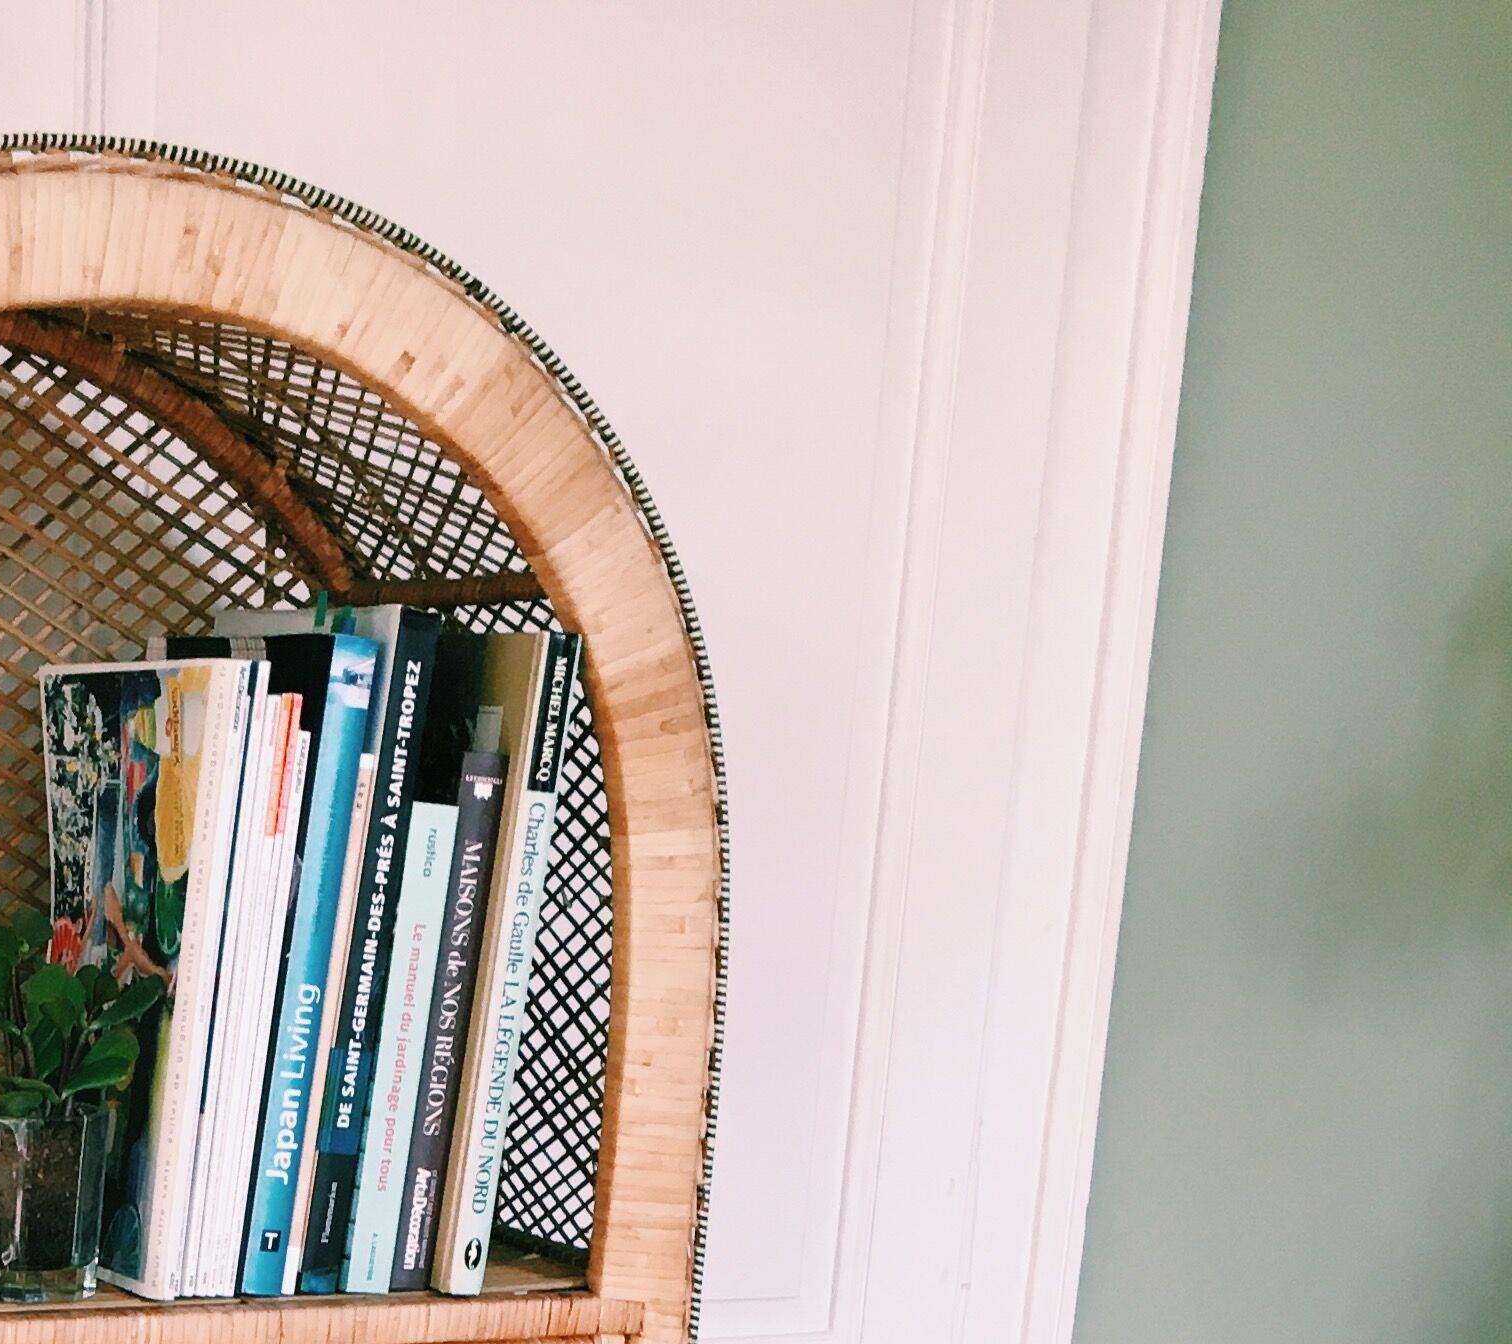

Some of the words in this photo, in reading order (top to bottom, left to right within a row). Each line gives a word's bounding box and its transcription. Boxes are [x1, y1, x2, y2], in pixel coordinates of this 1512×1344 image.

[547, 655, 568, 721] MICHEL
[387, 659, 421, 809] SAINT-TROPEZ
[535, 721, 558, 782] MARCQ
[380, 813, 398, 829] À
[519, 802, 547, 876] Charles
[423, 827, 438, 878] rustica
[450, 839, 484, 947] MAISONS
[515, 880, 534, 907] de
[414, 923, 426, 943] Le
[504, 911, 530, 975] Gaulle
[341, 833, 395, 1098] SAINT-GERMAIN-DES-PRÉS
[404, 948, 421, 1008] manuel
[445, 951, 467, 978] de
[500, 981, 520, 1008] LA
[280, 983, 320, 1080] Living
[399, 1011, 414, 1033] du
[438, 980, 463, 1031] NOS
[386, 1036, 409, 1113] jardinage
[422, 1034, 456, 1137] RÉGIONS
[486, 1015, 515, 1114] LÉGENDE
[265, 1088, 302, 1185] Japan
[336, 1102, 353, 1129] DE
[382, 1117, 397, 1152] pour
[480, 1119, 499, 1149] DU
[377, 1159, 392, 1192] tous
[471, 1155, 494, 1215] NORD
[264, 1232, 279, 1250] T
